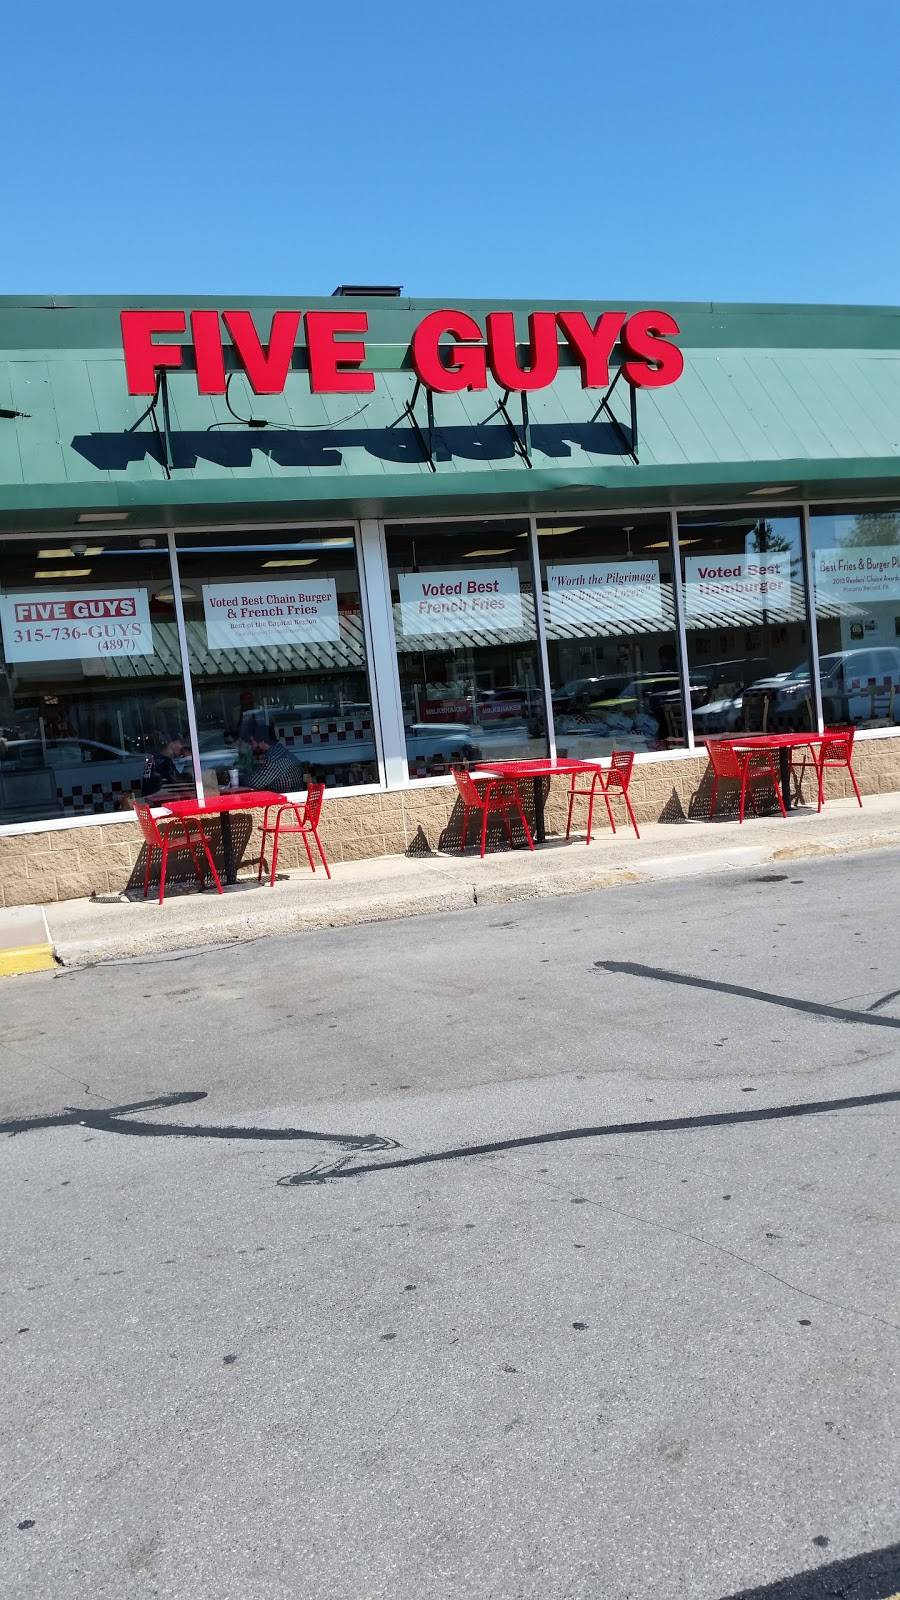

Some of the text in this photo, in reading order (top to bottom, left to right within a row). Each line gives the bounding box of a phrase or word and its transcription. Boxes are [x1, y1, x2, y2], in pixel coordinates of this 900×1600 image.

[120, 308, 684, 395] FIVE GUYS
[697, 563, 781, 579] Voted Best
[820, 560, 837, 572] Best
[838, 559, 857, 571] Fries
[858, 558, 865, 570] &
[866, 557, 890, 572] Burger
[551, 571, 656, 587] "Worth the Pilgrimage
[422, 580, 499, 596] Voted Best
[699, 581, 783, 595] Hamburger
[209, 592, 332, 608] Voted Best Chain Burger
[418, 597, 505, 614] French Fries
[16, 599, 135, 621] FIVE GUYS
[227, 604, 318, 619] & French Fries
[14, 622, 142, 643] 315-736-GUYS
[97, 639, 136, 652] (4897)
